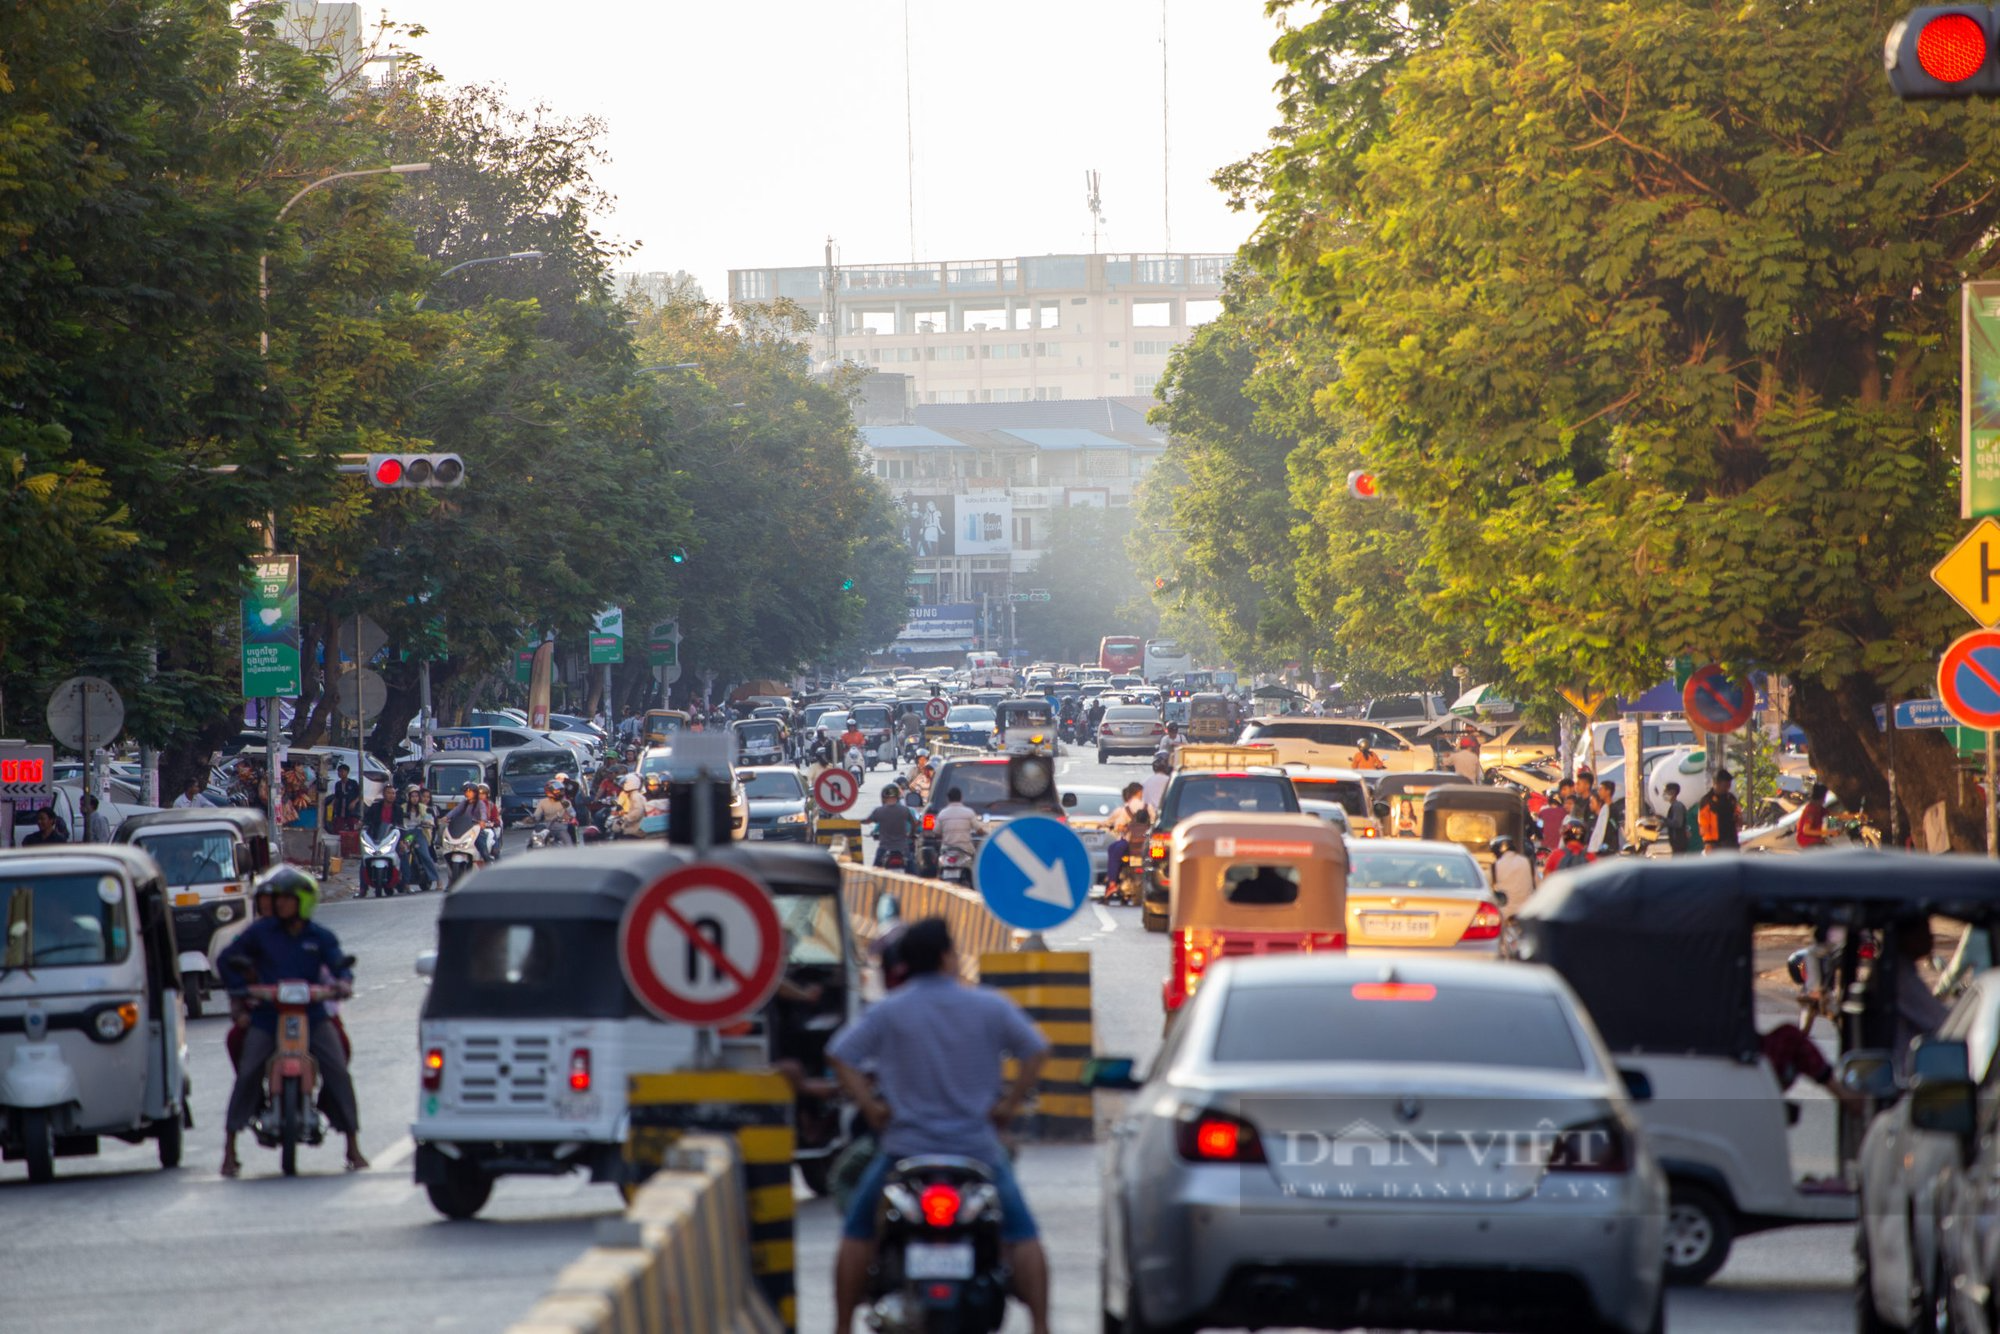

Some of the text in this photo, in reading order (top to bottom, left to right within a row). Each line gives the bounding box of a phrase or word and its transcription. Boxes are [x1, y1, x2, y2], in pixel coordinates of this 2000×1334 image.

[256, 563, 289, 578] 4.5G
[263, 584, 279, 593] HD
[908, 608, 938, 618] SUNG
